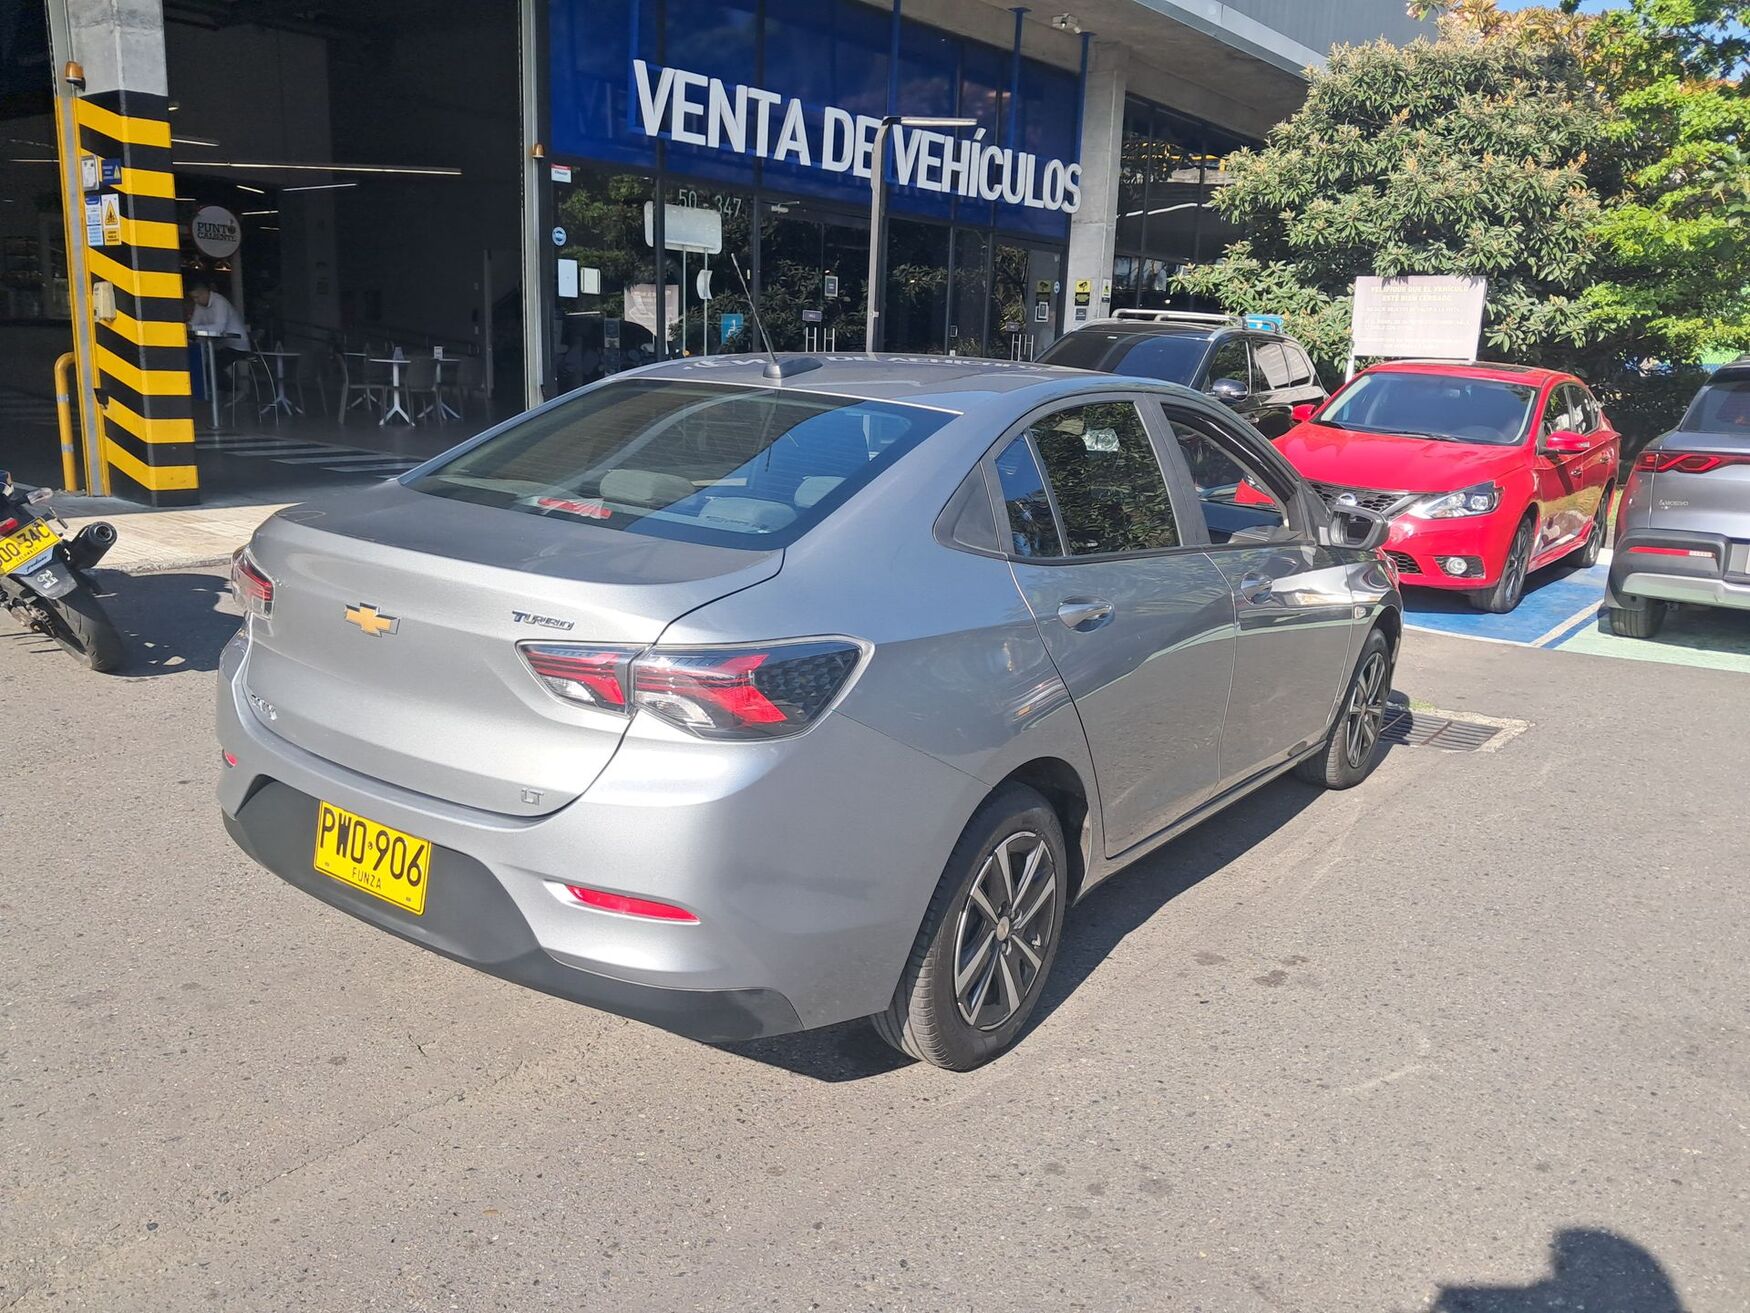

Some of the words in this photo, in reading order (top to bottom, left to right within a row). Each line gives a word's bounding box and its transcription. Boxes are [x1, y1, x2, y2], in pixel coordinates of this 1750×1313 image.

[633, 59, 811, 167] VENTA
[822, 106, 882, 178] DE
[893, 127, 1083, 214] VEHÍCULOS
[679, 189, 697, 208] 50
[512, 610, 575, 631] TURBO
[320, 806, 367, 864] PWO
[372, 830, 425, 887] 906
[351, 867, 382, 889] FUNZA
